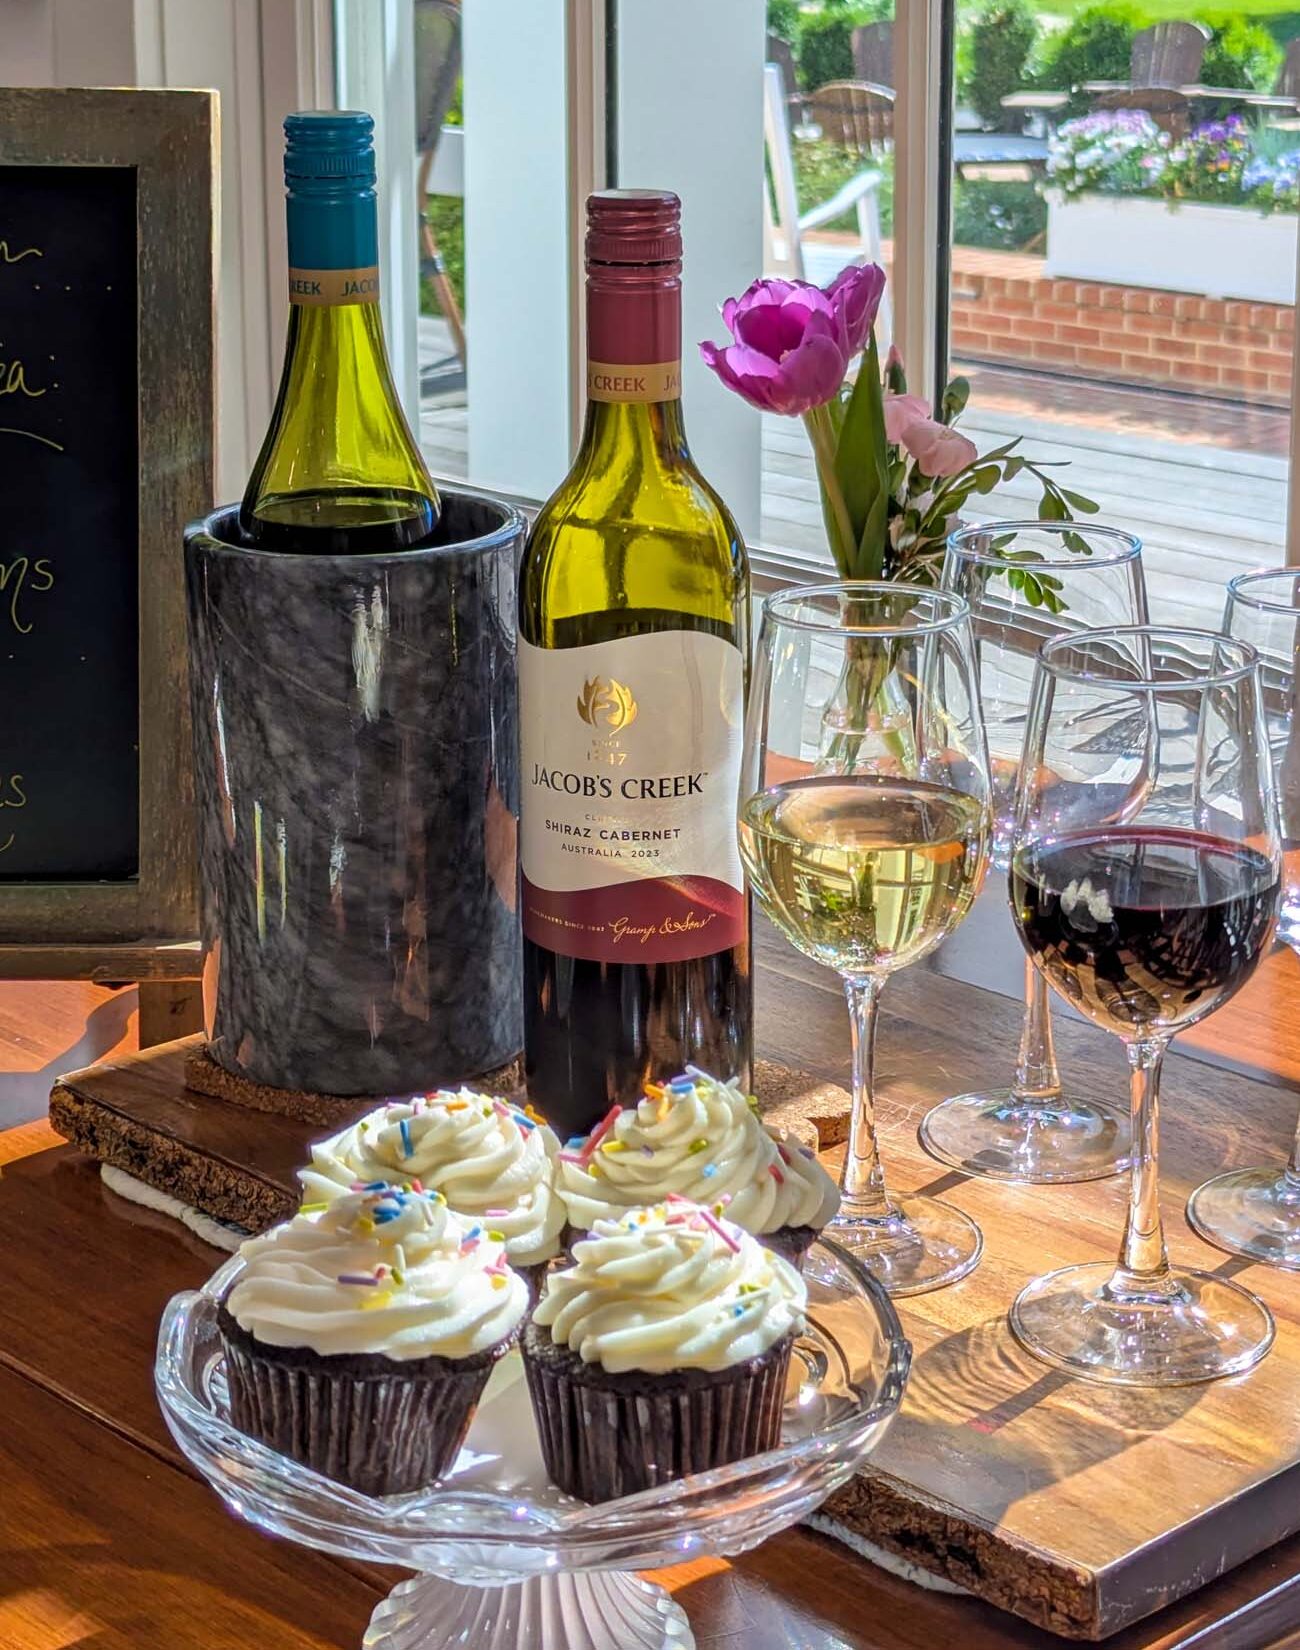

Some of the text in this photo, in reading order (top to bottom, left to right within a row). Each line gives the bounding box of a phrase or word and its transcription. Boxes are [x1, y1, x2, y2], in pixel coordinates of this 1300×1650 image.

[290, 277, 380, 297] REEK JACO
[593, 375, 646, 392] CREEK
[531, 764, 613, 798] JACOB'S
[545, 819, 592, 838] SHIRAZ
[600, 828, 681, 841] CABERNET
[561, 843, 660, 858] AUSTRALIA 2023
